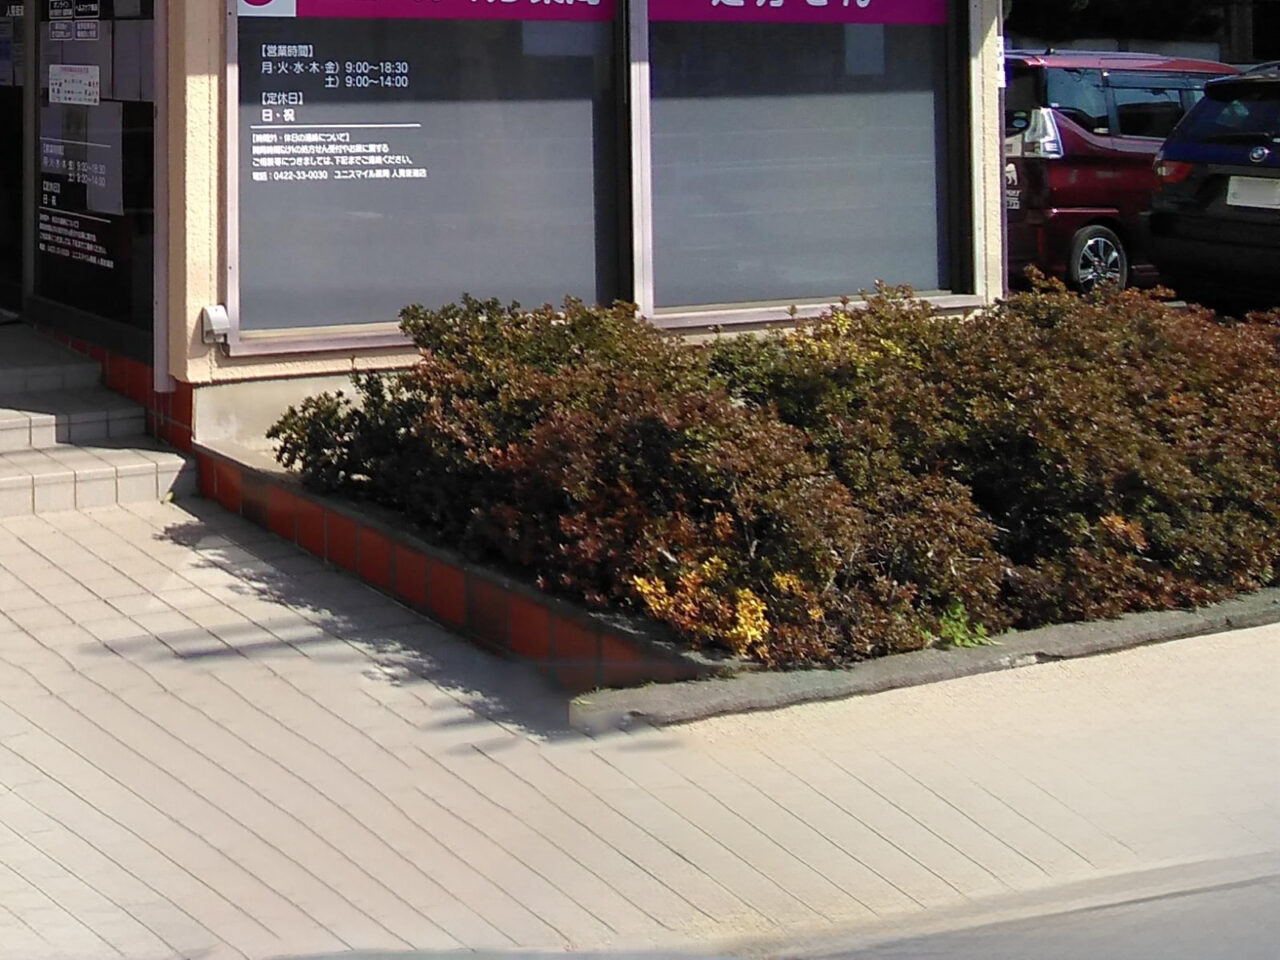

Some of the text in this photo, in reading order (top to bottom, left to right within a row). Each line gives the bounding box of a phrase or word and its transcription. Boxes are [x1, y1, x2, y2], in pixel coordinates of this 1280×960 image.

[261, 44, 314, 58] 【営業時間】
[261, 92, 304, 105] 【定休日】
